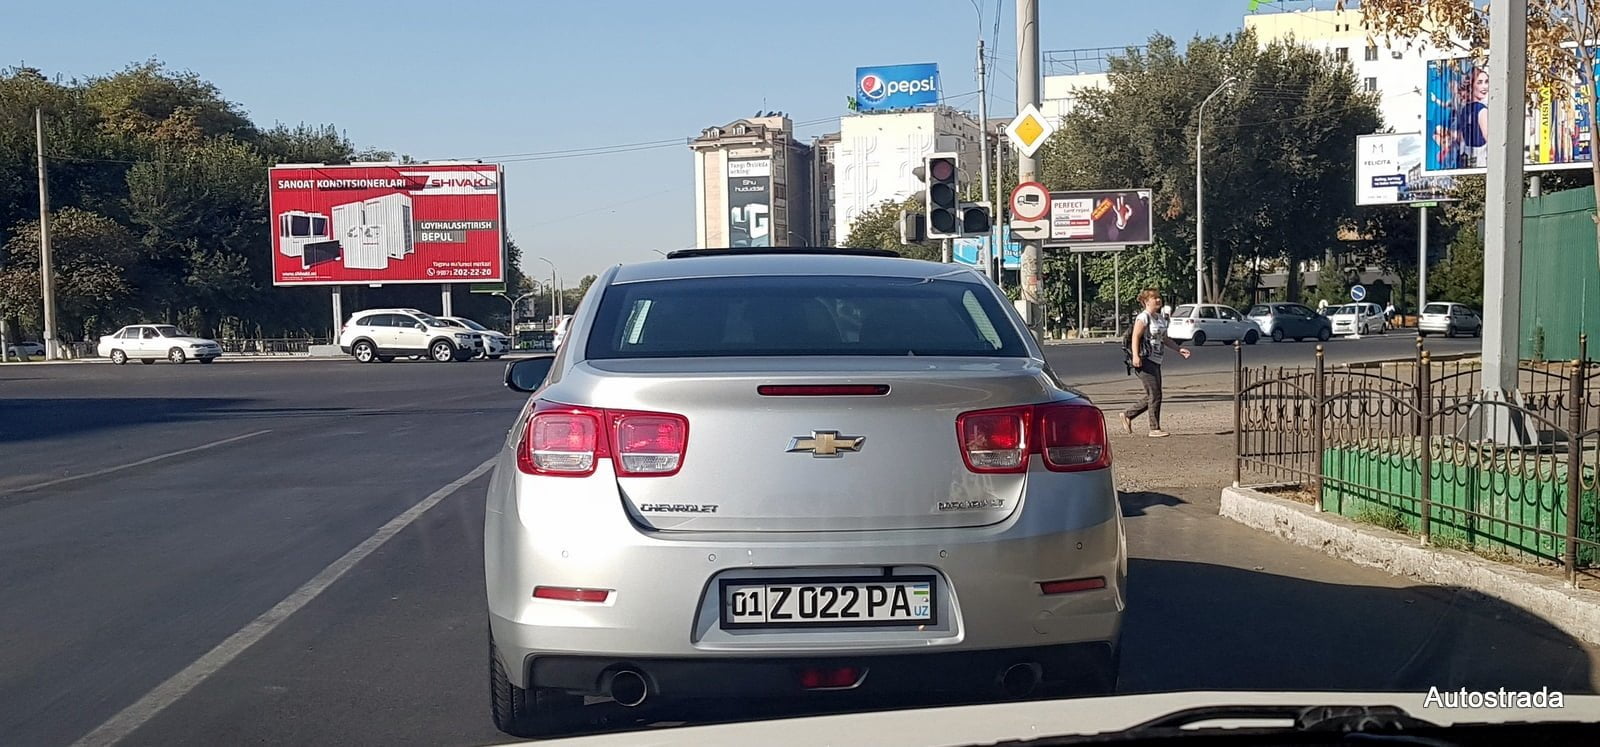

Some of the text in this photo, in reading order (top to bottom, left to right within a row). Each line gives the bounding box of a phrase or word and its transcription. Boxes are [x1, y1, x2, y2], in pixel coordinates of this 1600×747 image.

[887, 76, 936, 96] pepsi
[278, 179, 406, 189] SANOAT KONDITSIONERLARI
[431, 179, 488, 187] SHIVAKI
[421, 222, 492, 230] LOYIHALASHTIRISH
[421, 232, 453, 241] BEPUL
[640, 503, 719, 513] CHEVROLET
[731, 591, 763, 617] 01
[914, 605, 929, 616] UZ
